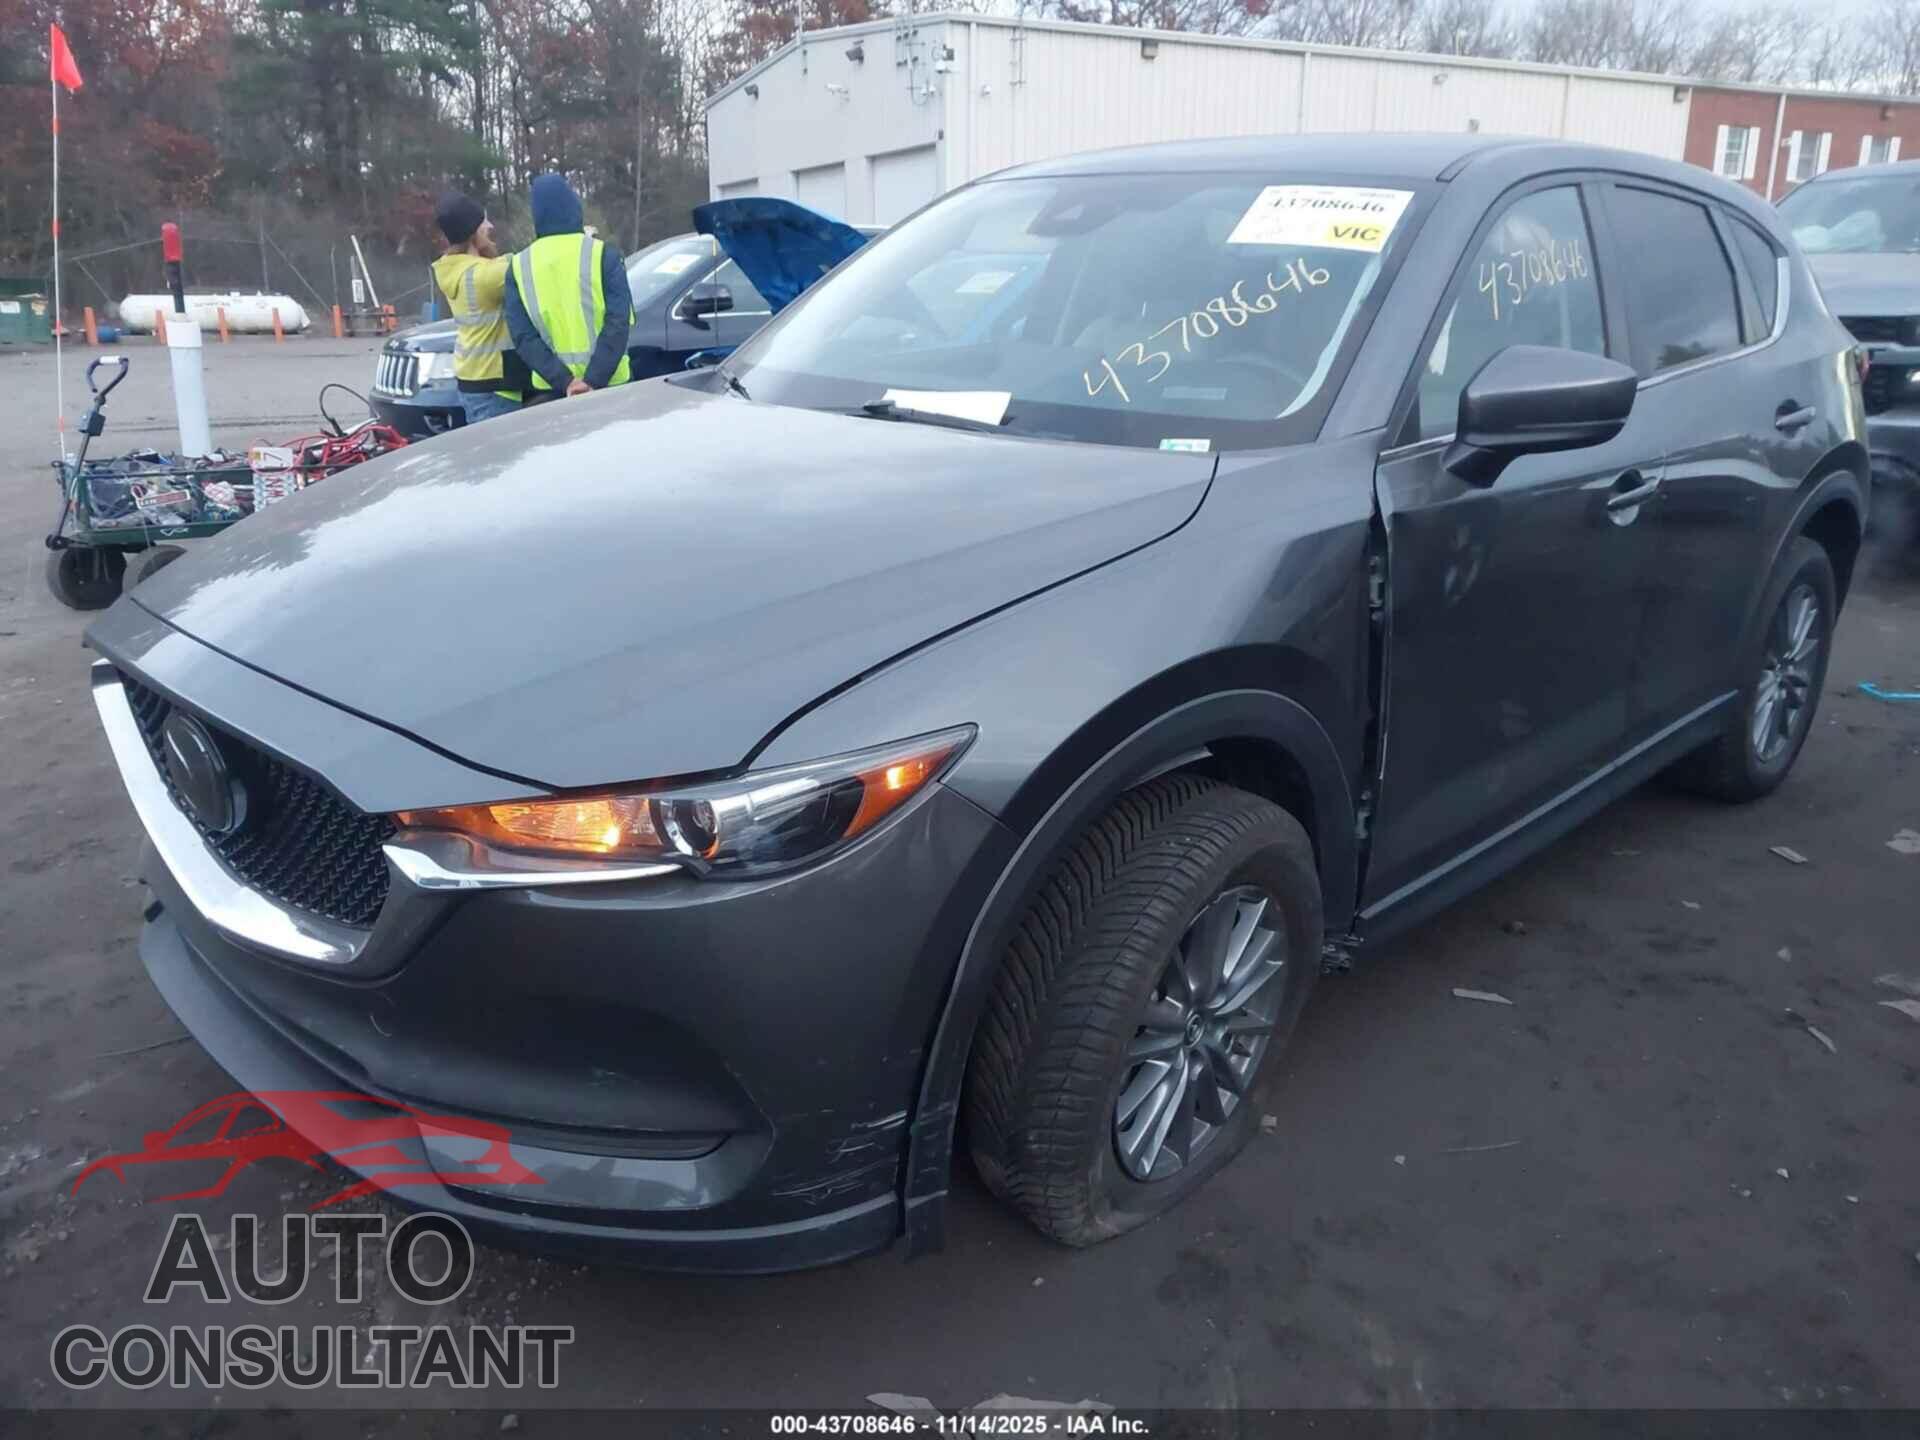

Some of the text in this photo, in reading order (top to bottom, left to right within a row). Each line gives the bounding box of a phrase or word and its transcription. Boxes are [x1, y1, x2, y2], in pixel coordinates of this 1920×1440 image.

[1332, 225, 1380, 241] VIC
[1479, 239, 1588, 320] 43708646
[1084, 258, 1330, 402] 43708646
